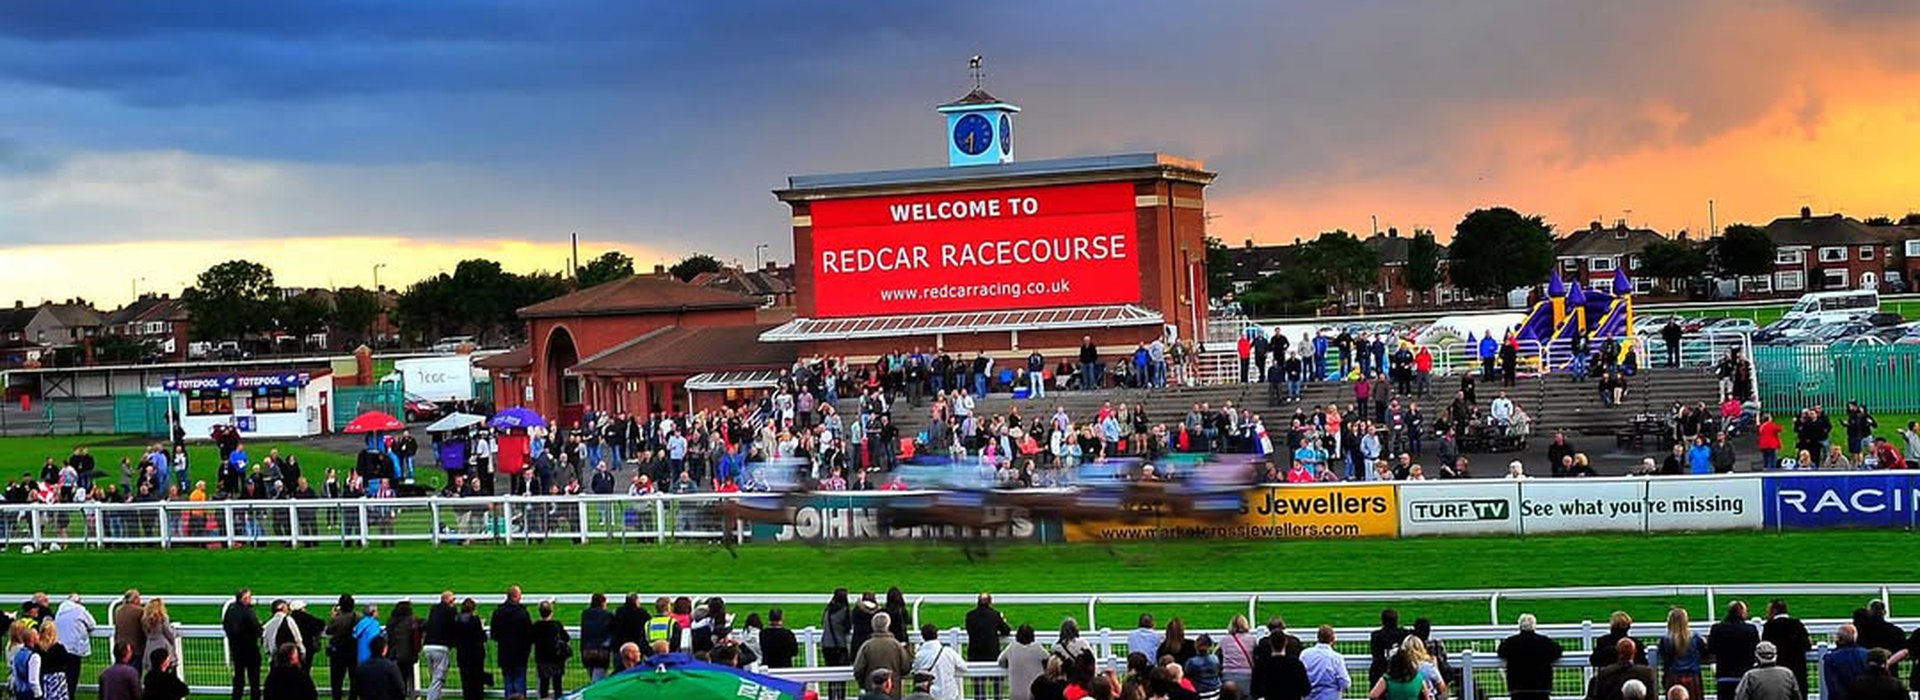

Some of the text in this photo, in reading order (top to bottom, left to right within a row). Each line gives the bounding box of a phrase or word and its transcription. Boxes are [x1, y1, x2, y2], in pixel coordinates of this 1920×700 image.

[890, 197, 1039, 222] WELCOME TO
[822, 234, 1127, 274] REDCAR RACECOURSE
[881, 278, 1070, 301] www.redcarracing.co.uk
[178, 379, 220, 389] TOTEPOOL
[238, 376, 281, 387] TOTEPOOL
[1258, 491, 1387, 516] Jewellers
[1415, 502, 1505, 518] TURF TV
[1521, 500, 1553, 517] See
[1560, 498, 1604, 516] what
[1673, 494, 1744, 516] missing
[776, 507, 880, 541] JOHN
